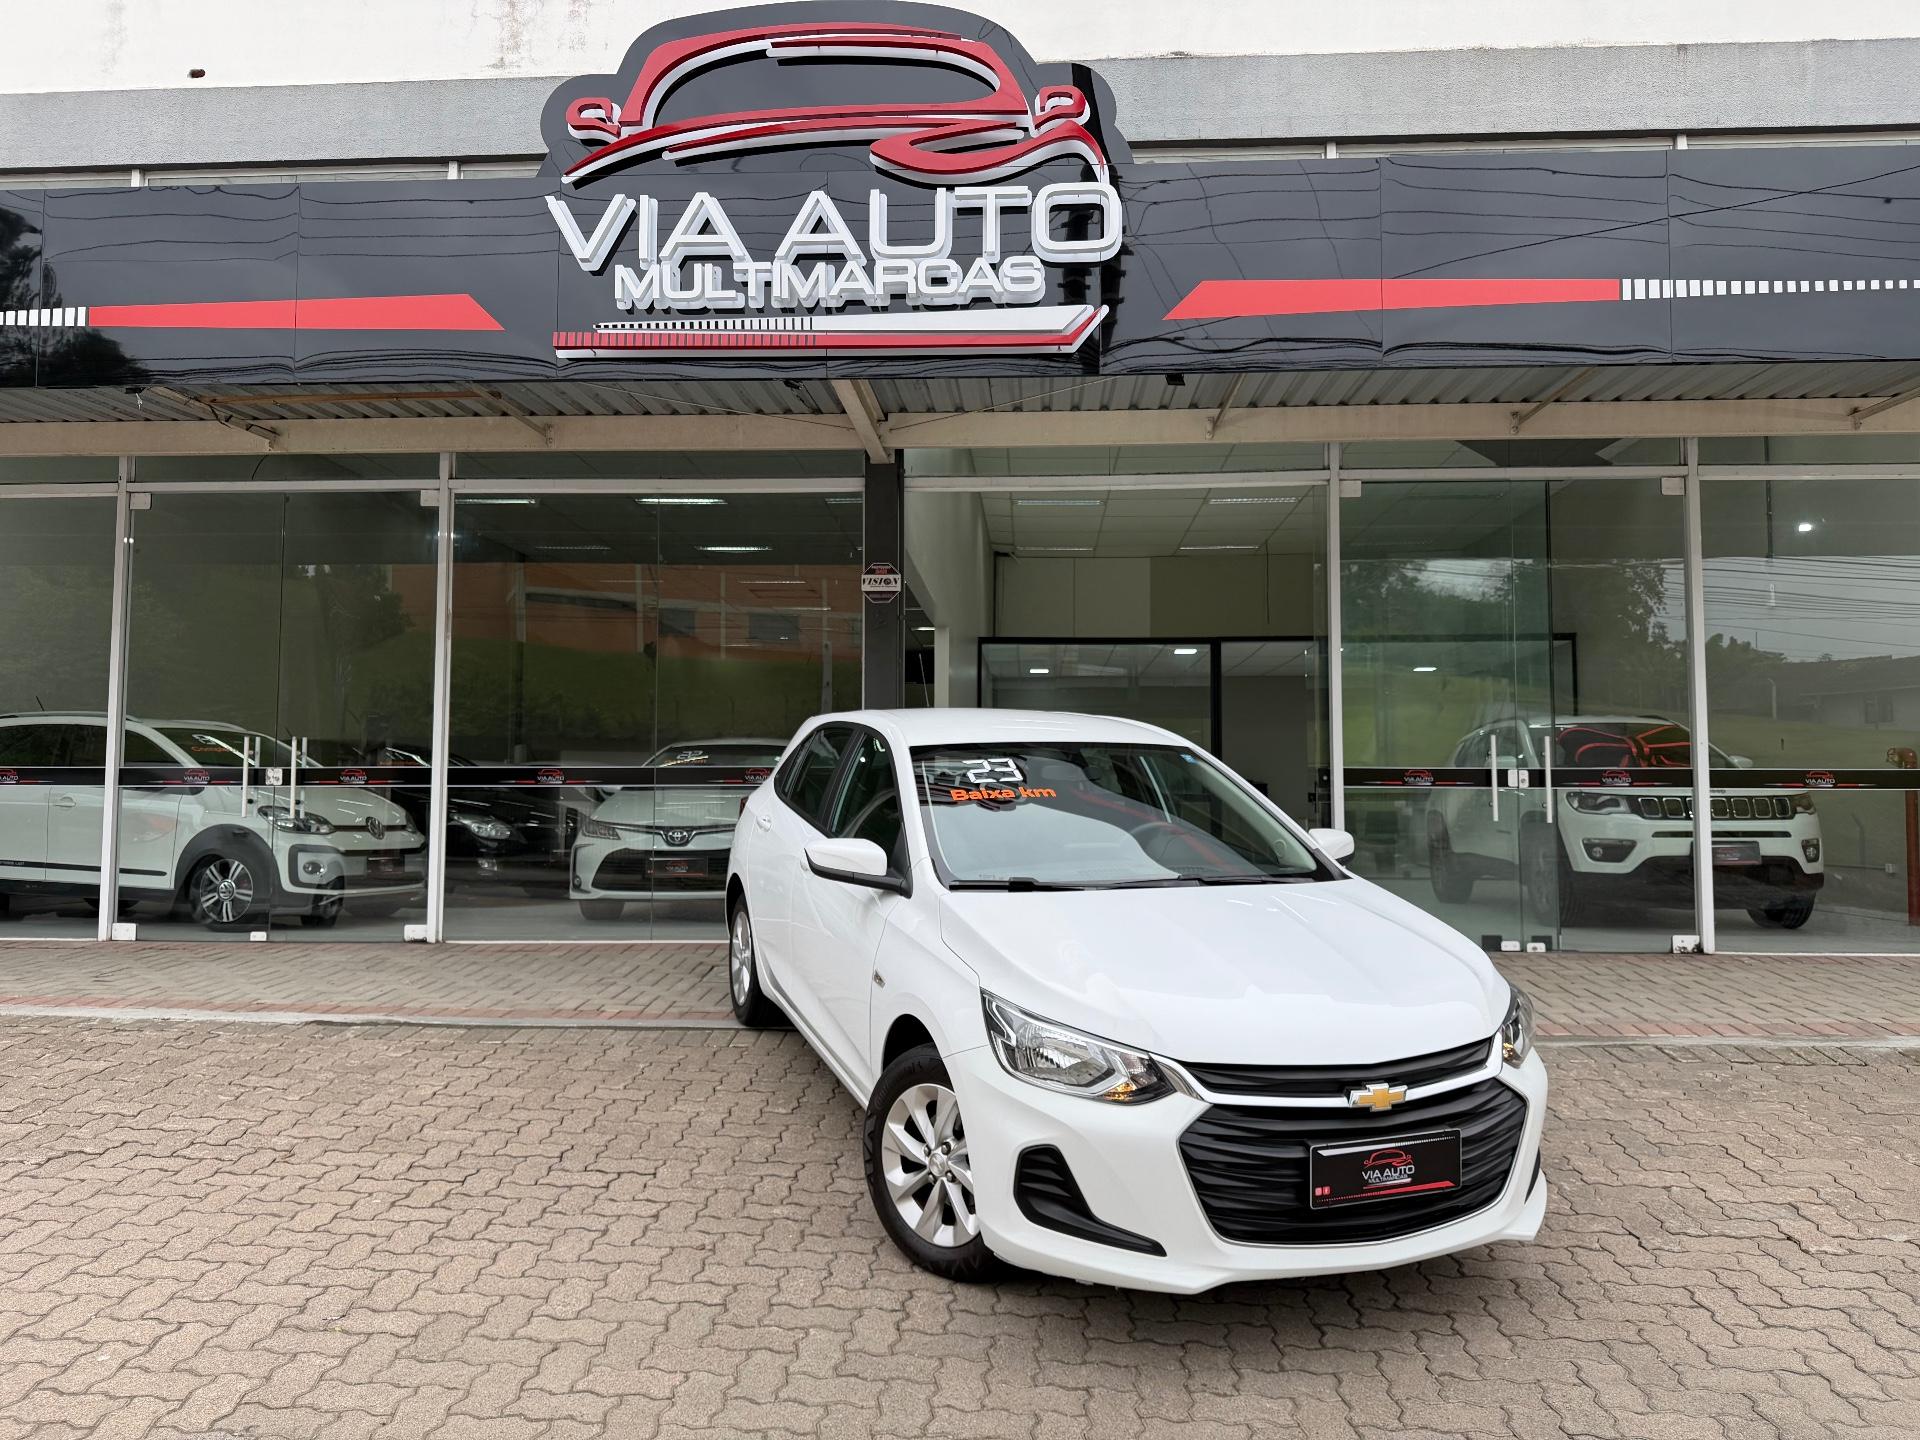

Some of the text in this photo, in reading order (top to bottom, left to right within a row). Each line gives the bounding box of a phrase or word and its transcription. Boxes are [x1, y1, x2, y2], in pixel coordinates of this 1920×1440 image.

[544, 182, 1124, 271] VIA AUTO
[613, 254, 1047, 309] MULTIMARCAS
[961, 757, 1023, 783] 23
[950, 786, 1057, 801] Baixa km
[1362, 1165, 1415, 1180] VIA AUTO
